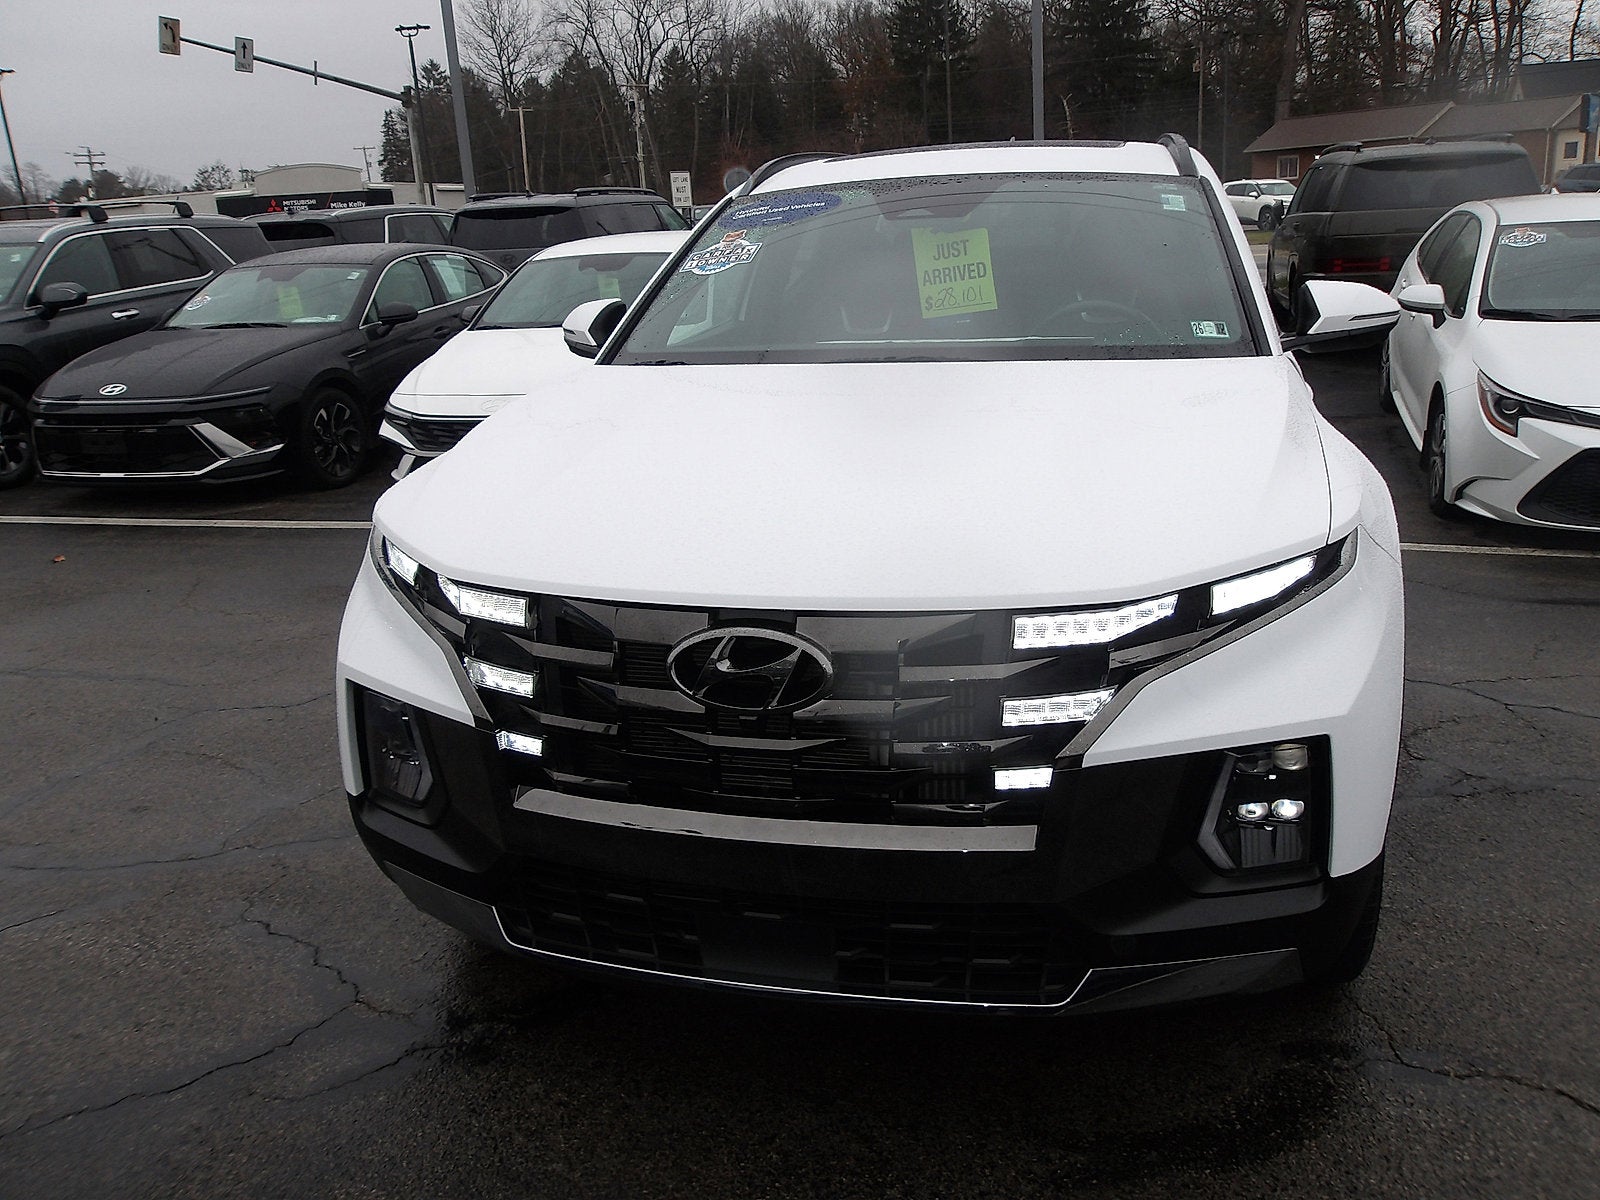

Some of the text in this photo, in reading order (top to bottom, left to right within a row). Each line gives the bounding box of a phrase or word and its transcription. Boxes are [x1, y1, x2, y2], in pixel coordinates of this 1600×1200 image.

[768, 206, 791, 214] Used
[791, 202, 825, 210] Vehicles
[692, 245, 757, 261] CARFAX
[932, 239, 970, 261] JUST
[697, 255, 749, 266] OWNER
[922, 262, 987, 287] ARRIVED
[1192, 323, 1205, 335] 26
